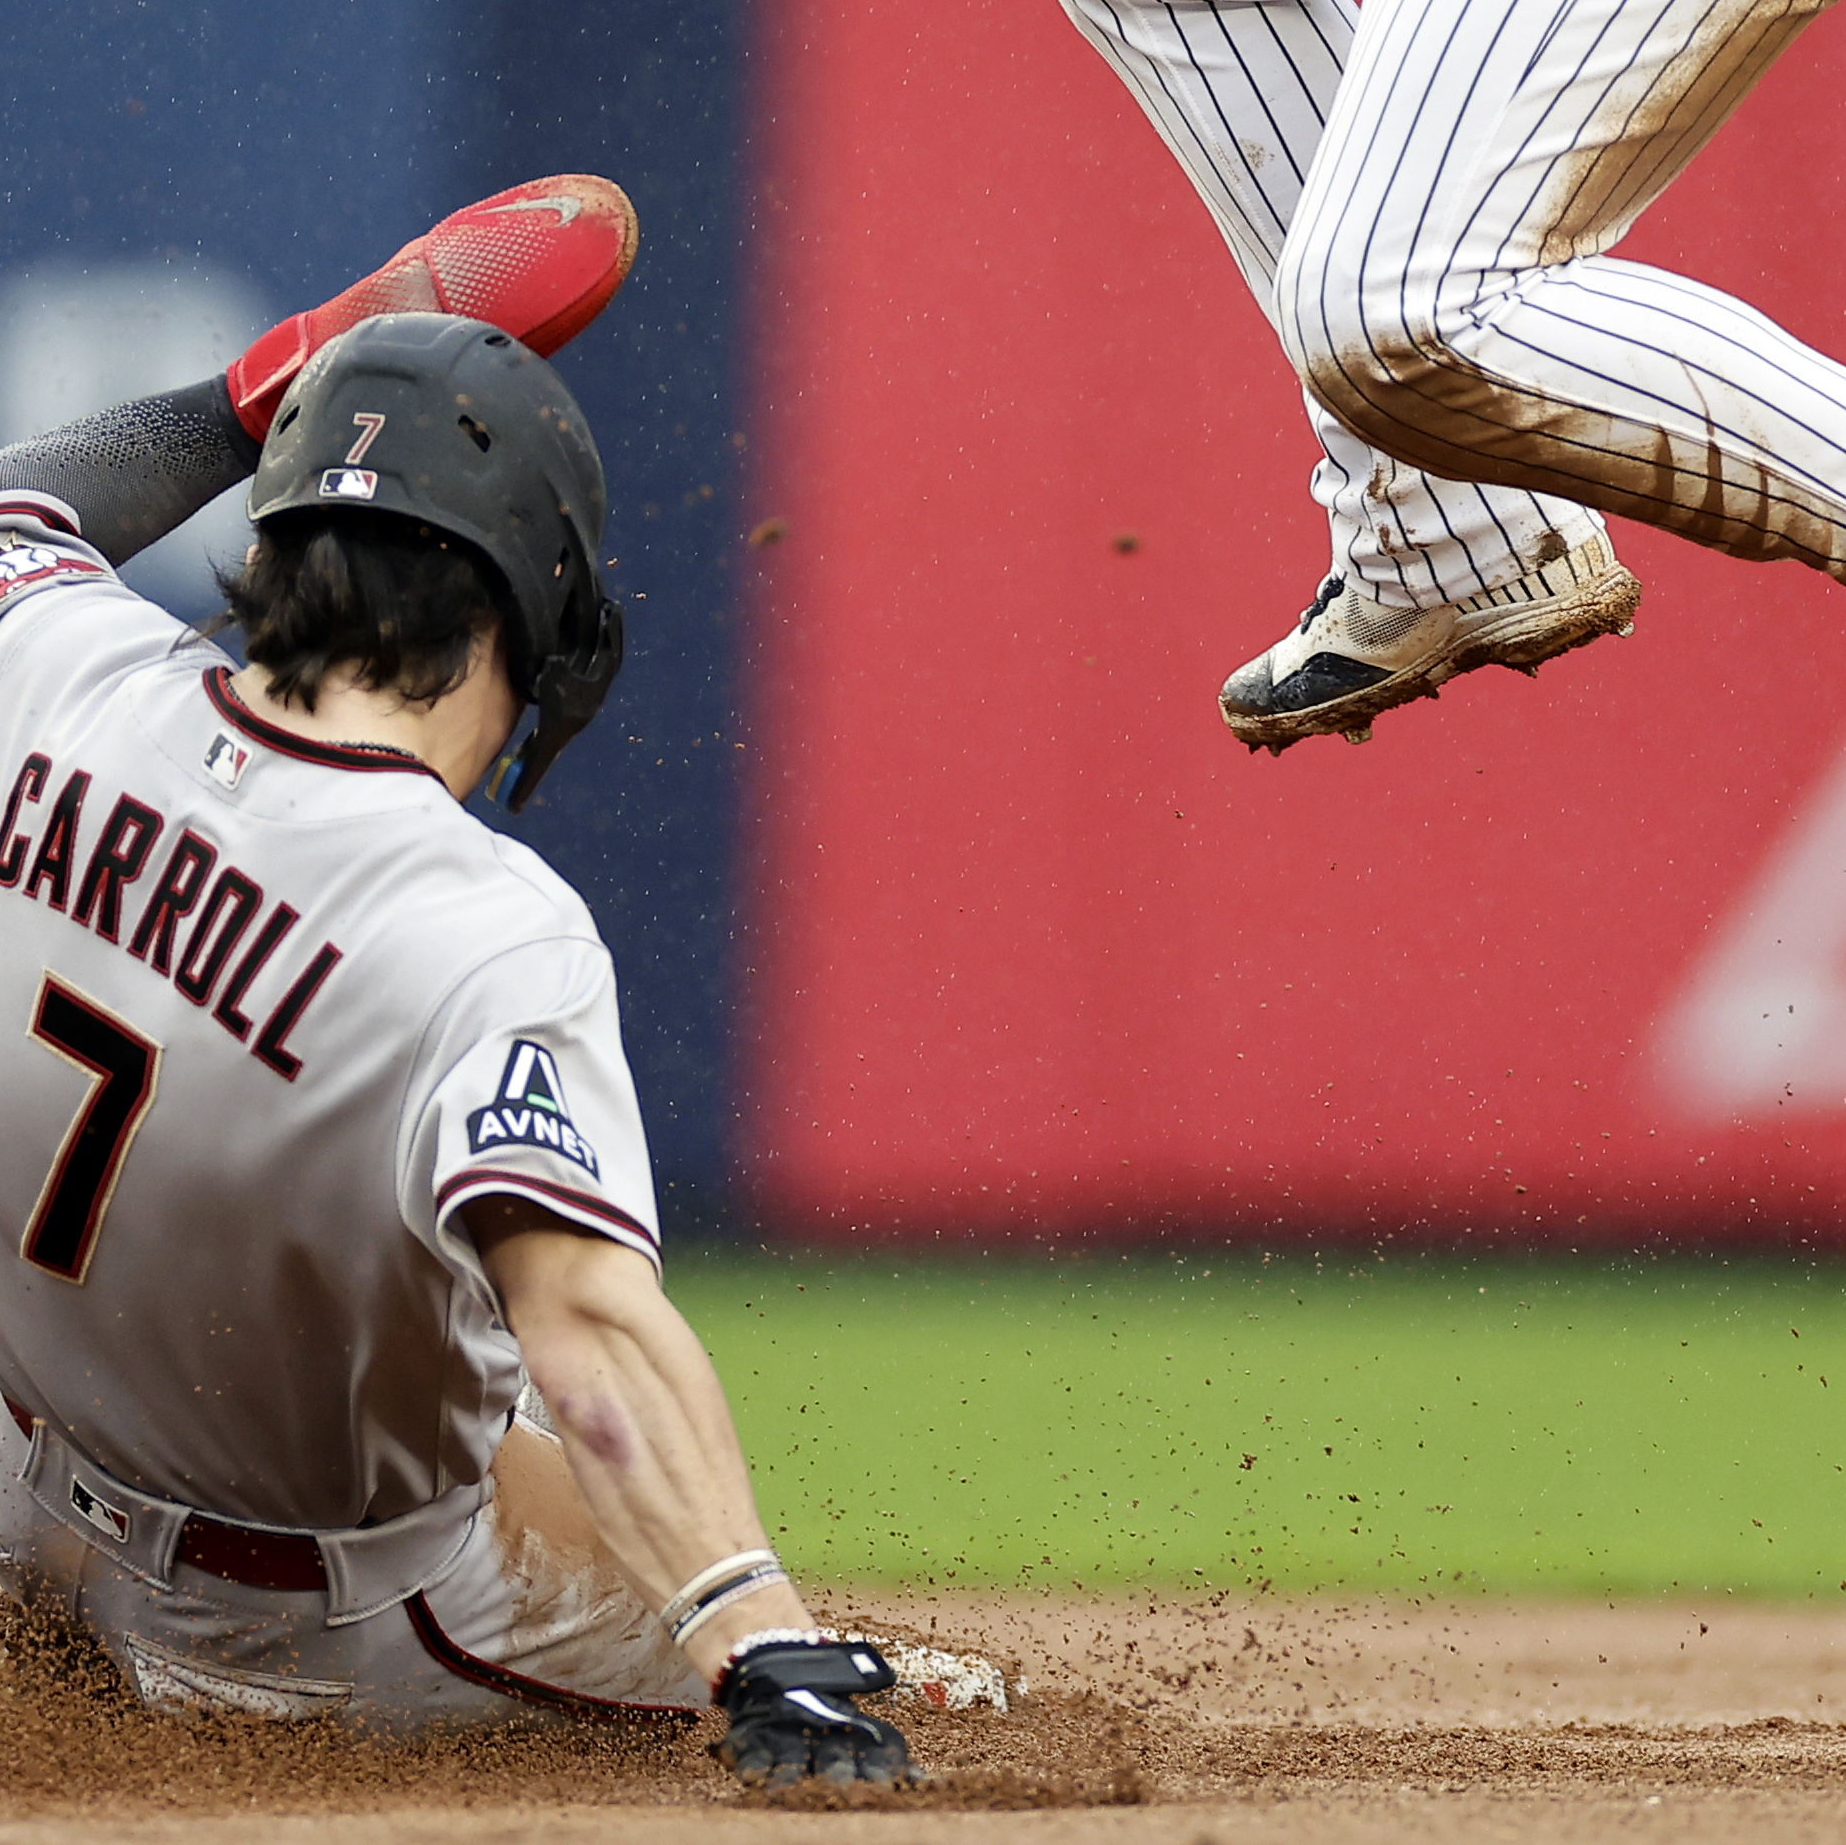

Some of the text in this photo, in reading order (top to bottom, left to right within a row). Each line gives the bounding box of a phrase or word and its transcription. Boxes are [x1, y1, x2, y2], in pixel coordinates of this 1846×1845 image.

[343, 411, 386, 465] 7
[20, 967, 165, 1285] 7
[476, 1107, 596, 1171] AVNET
